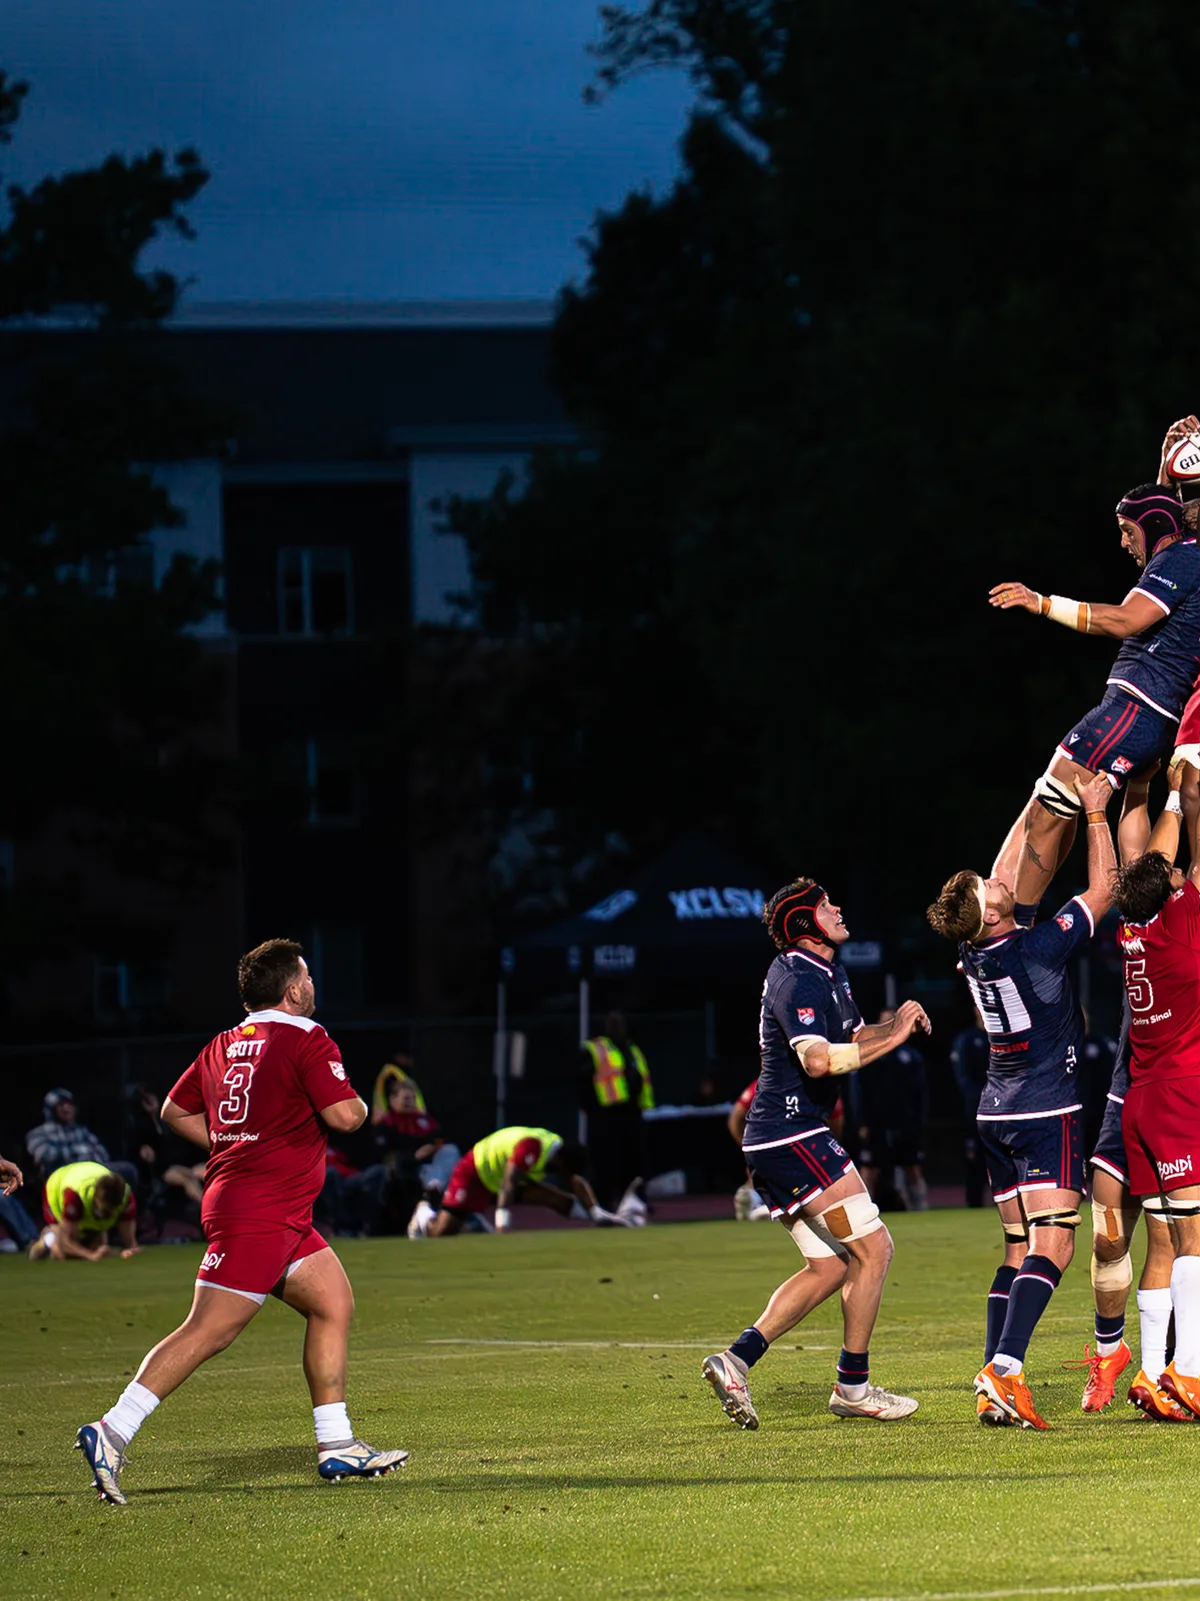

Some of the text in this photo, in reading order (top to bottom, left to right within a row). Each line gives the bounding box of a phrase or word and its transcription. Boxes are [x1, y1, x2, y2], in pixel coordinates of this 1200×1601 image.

[1125, 958, 1155, 1012] 5
[1150, 1009, 1172, 1025] Sinai
[226, 1039, 266, 1059] SCOTT
[218, 1062, 255, 1125] 3
